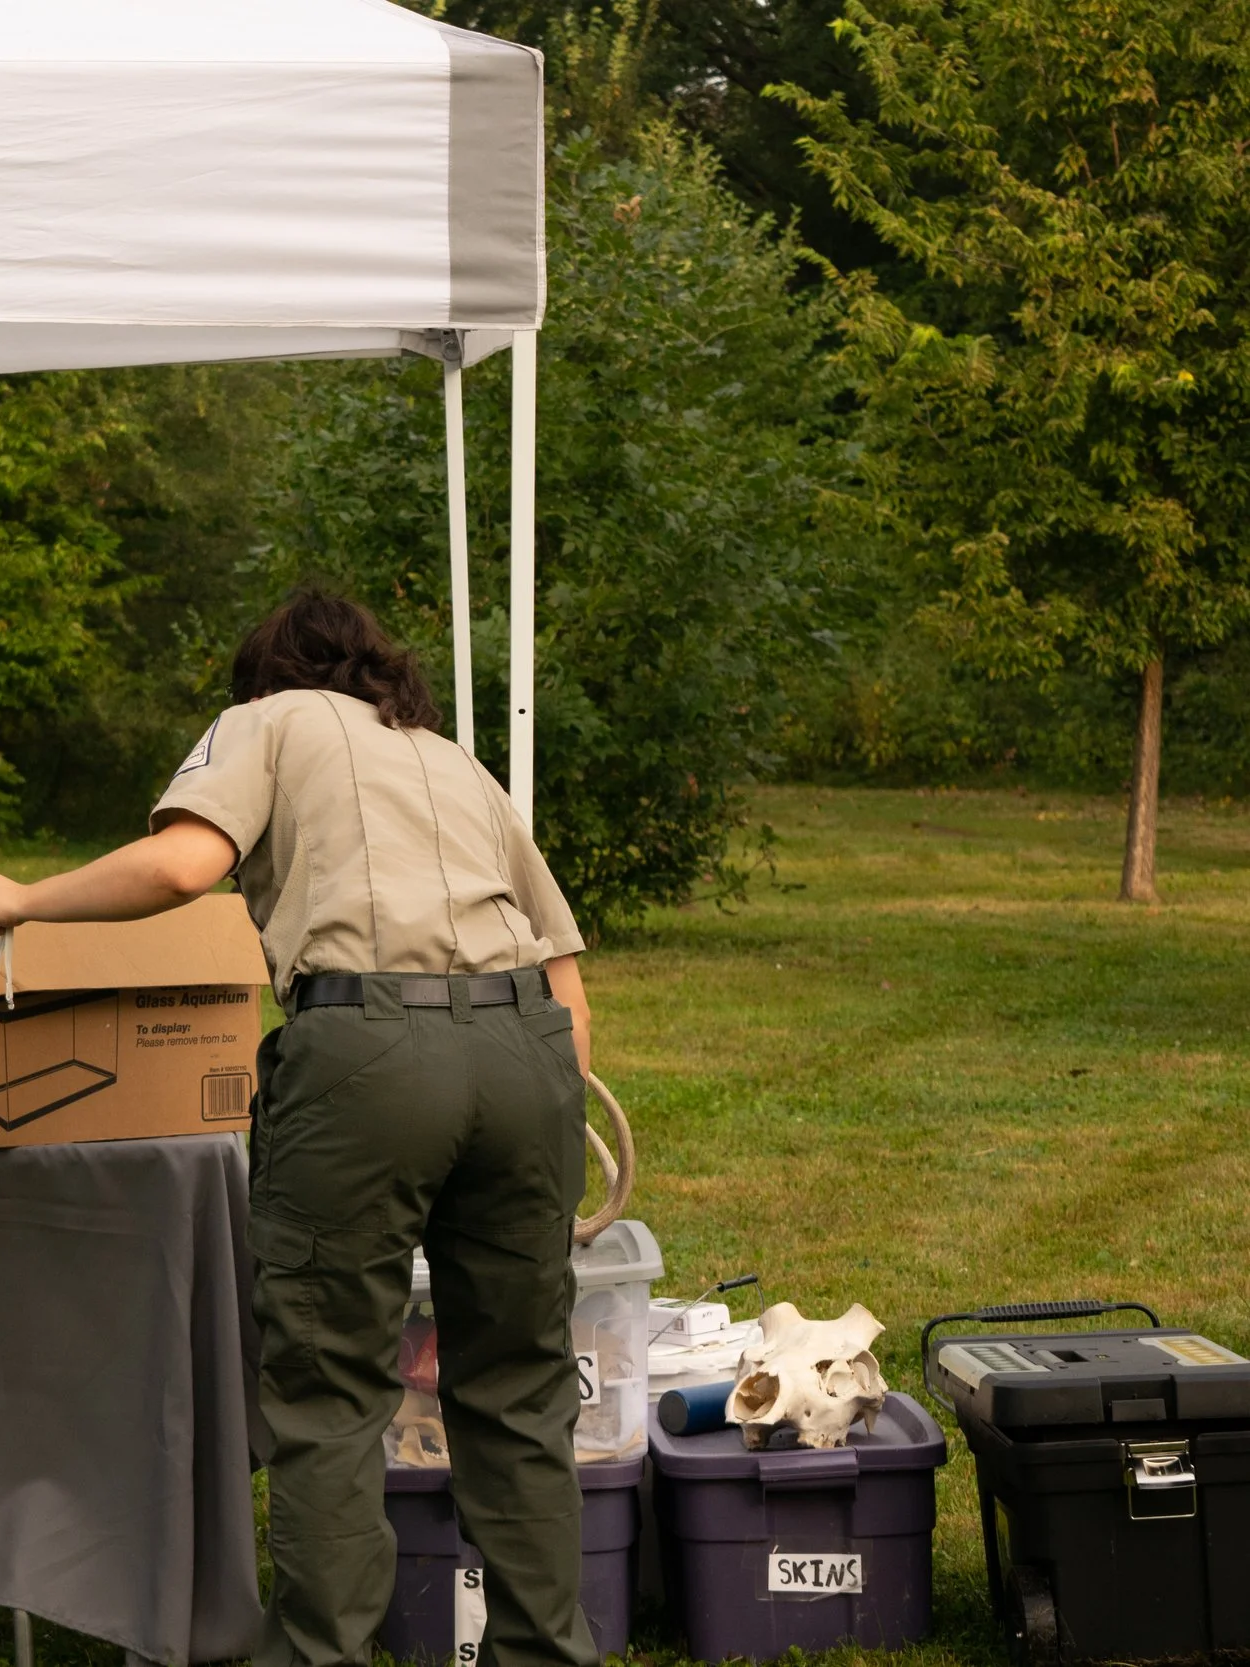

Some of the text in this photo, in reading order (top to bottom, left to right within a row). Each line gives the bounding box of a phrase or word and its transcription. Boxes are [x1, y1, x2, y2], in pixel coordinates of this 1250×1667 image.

[135, 990, 249, 1009] Glass Aquarium
[135, 1023, 191, 1036] To display:
[135, 1033, 238, 1048] Please remove from box
[778, 1559, 858, 1588] SKINS
